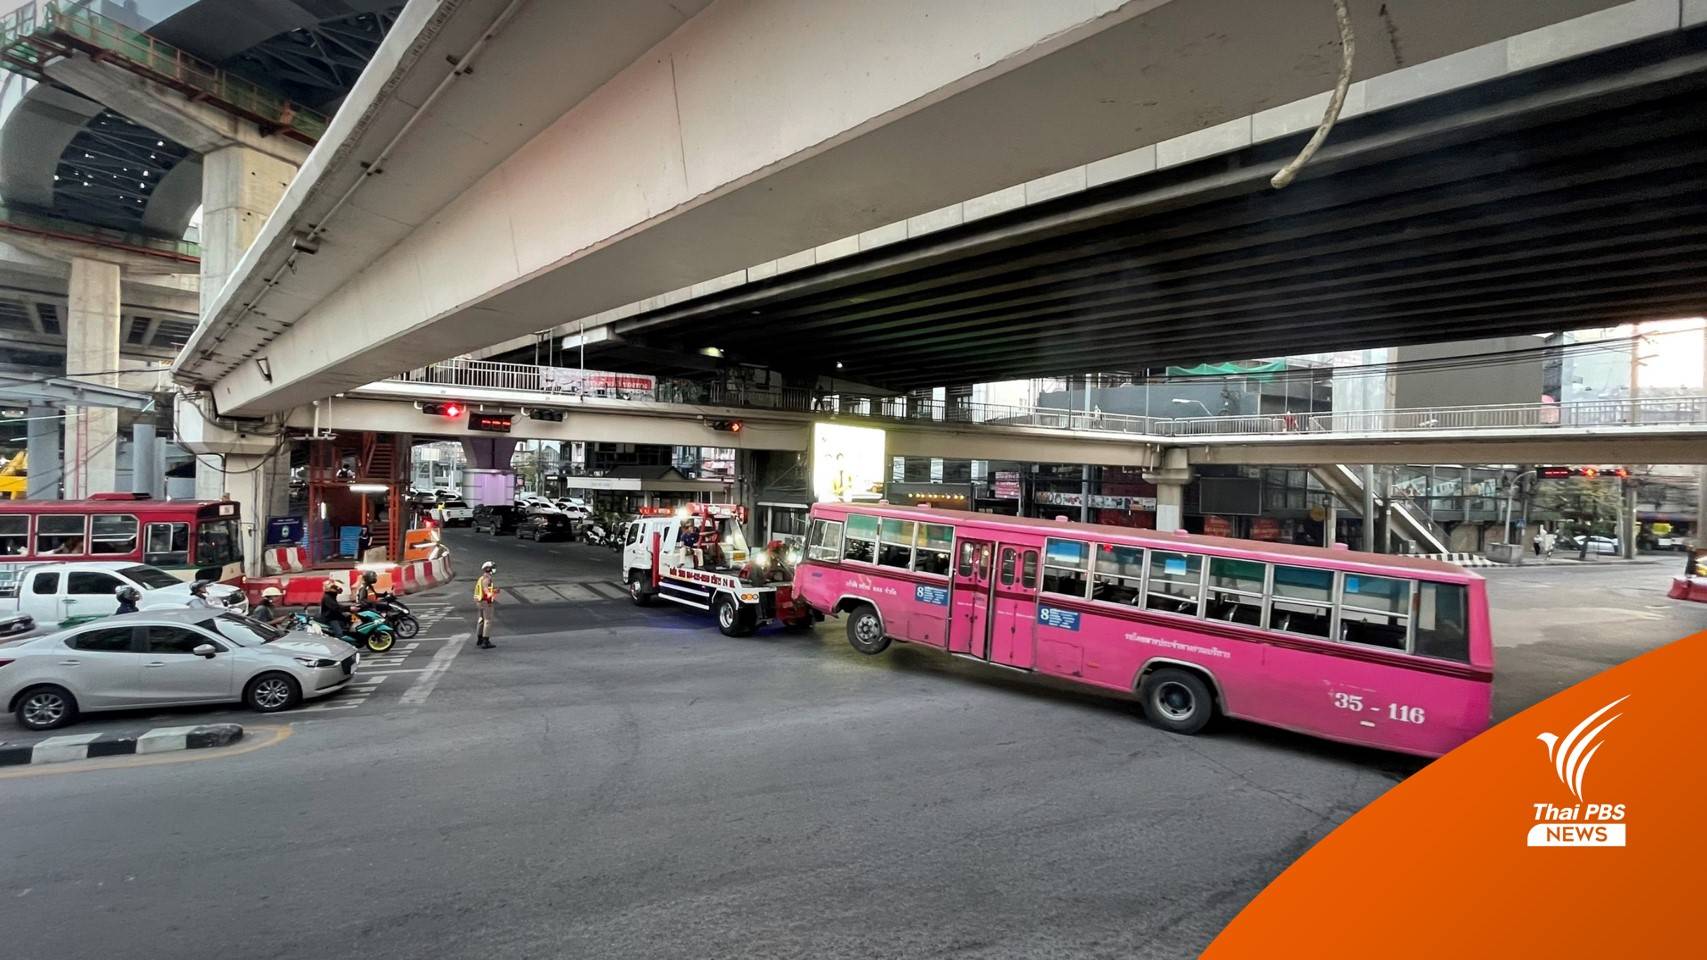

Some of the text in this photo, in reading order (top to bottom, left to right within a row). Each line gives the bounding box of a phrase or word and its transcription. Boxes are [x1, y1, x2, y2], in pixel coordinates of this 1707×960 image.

[916, 586, 924, 598] 8
[1040, 608, 1049, 620] 8
[1334, 692, 1364, 712] 35
[1388, 703, 1425, 724] 116
